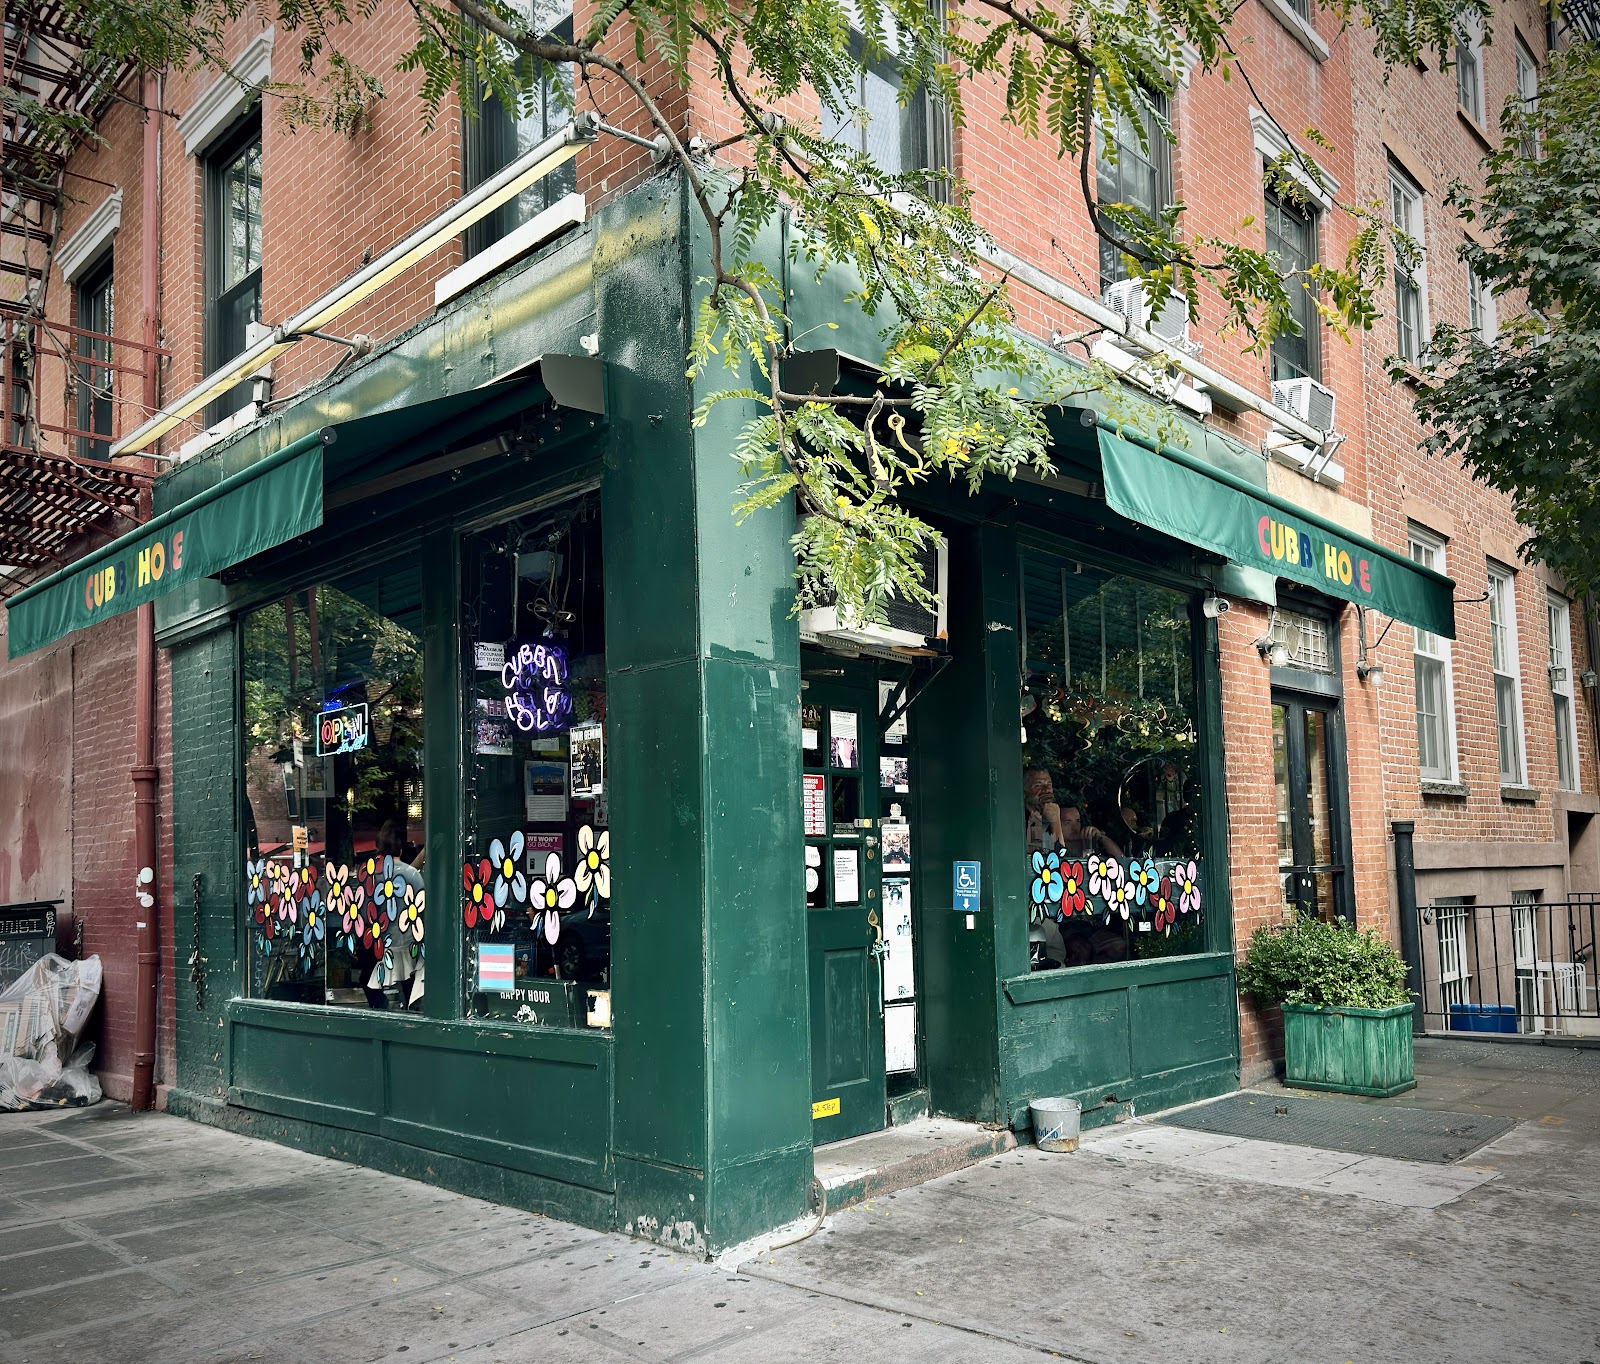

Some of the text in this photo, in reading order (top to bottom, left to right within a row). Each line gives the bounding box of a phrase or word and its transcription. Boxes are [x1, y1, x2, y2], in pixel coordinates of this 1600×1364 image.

[85, 530, 183, 610] CUBBY HOLE
[1258, 515, 1371, 593] CUBBY HOLE
[500, 989, 551, 1004] HAPPY HOUR
